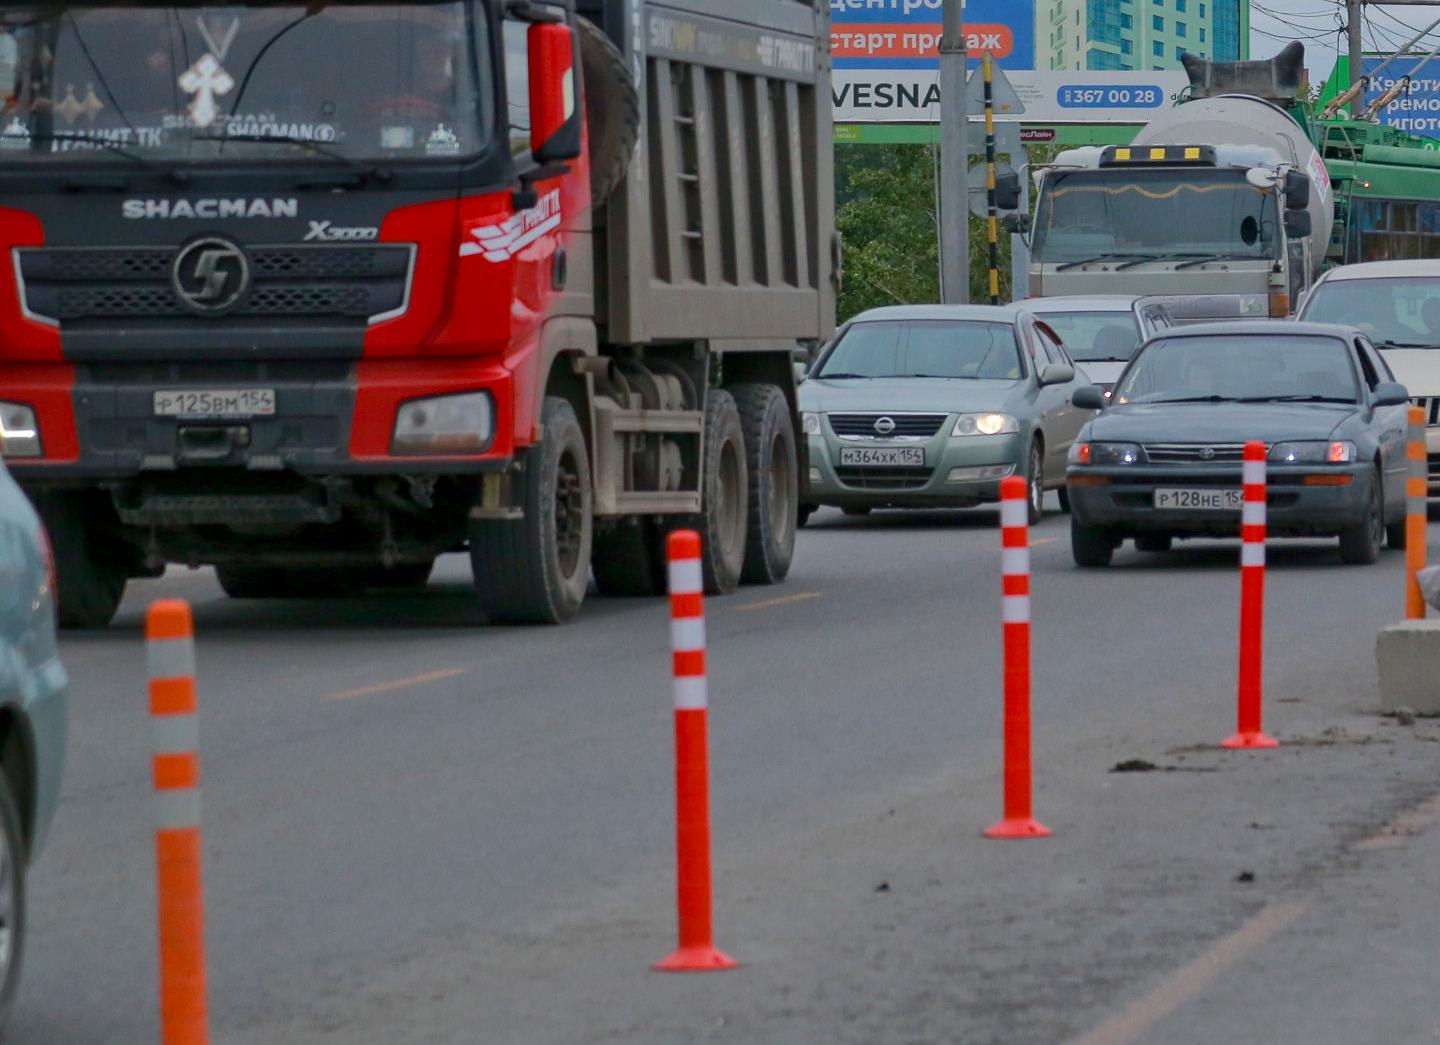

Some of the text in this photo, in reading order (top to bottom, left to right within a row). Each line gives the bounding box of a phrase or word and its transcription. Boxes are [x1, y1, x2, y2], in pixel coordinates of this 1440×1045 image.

[830, 32, 1002, 54] старт проаж
[831, 83, 941, 108] VESNA
[1074, 90, 1104, 103] 367
[1108, 90, 1130, 103] 00
[1134, 90, 1155, 103] 28
[122, 198, 298, 219] SHACMAN
[304, 220, 378, 241] X3000
